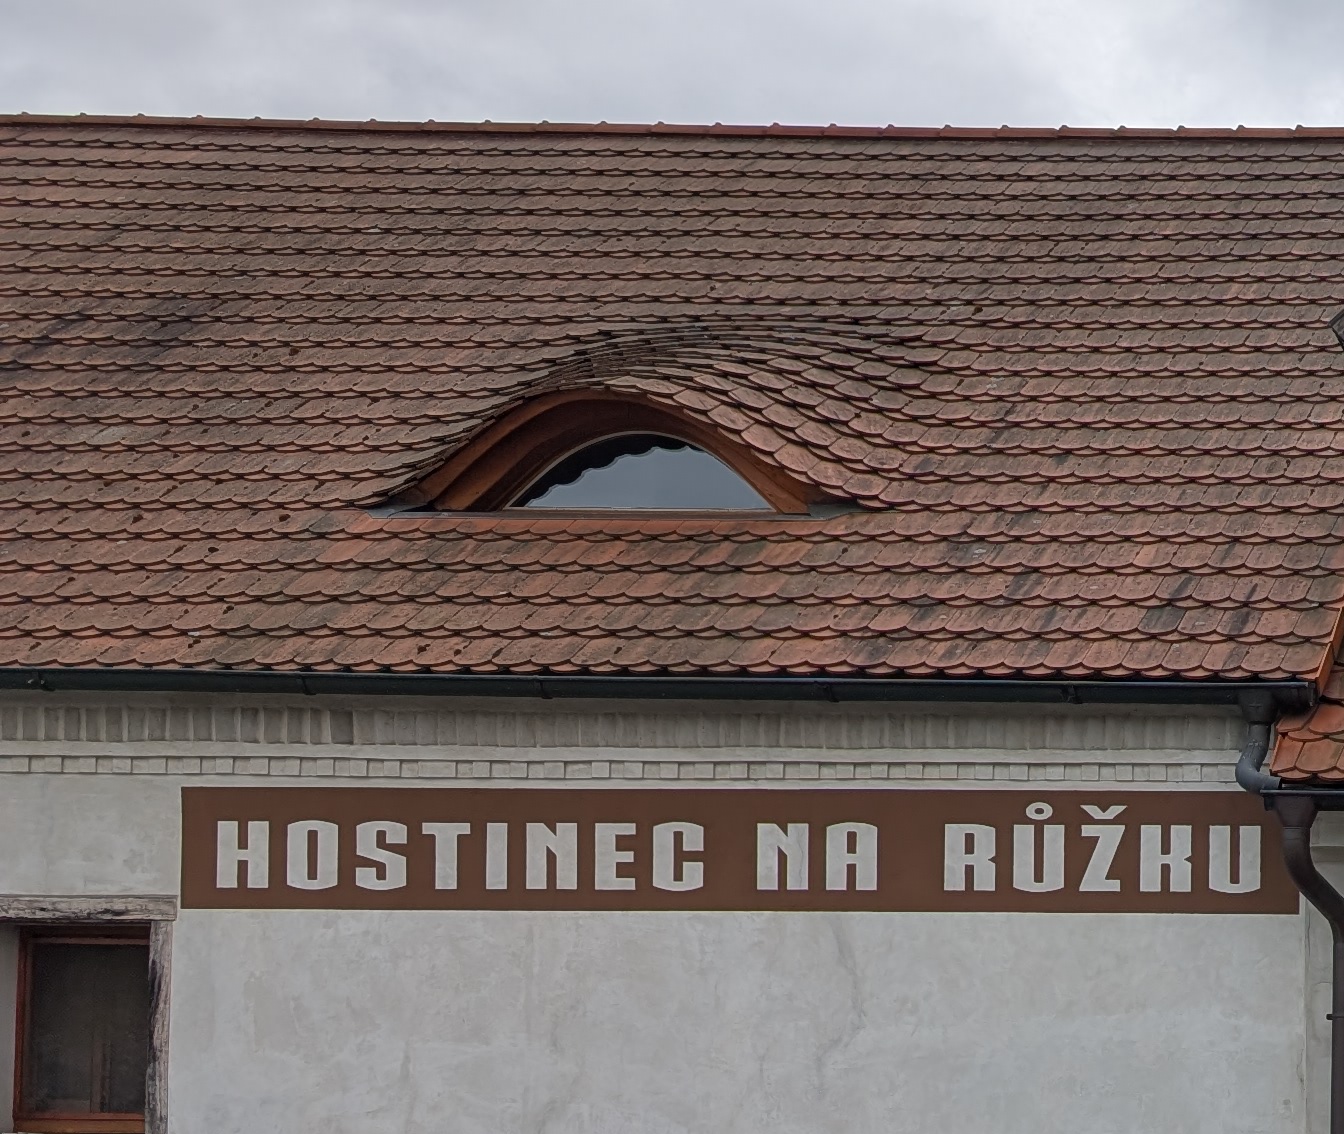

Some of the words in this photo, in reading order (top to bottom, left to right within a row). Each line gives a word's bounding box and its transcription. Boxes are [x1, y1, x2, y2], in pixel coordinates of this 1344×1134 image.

[217, 820, 704, 891] HOSTINEC
[757, 822, 877, 890] NA
[943, 802, 1261, 893] RŮŽKU
